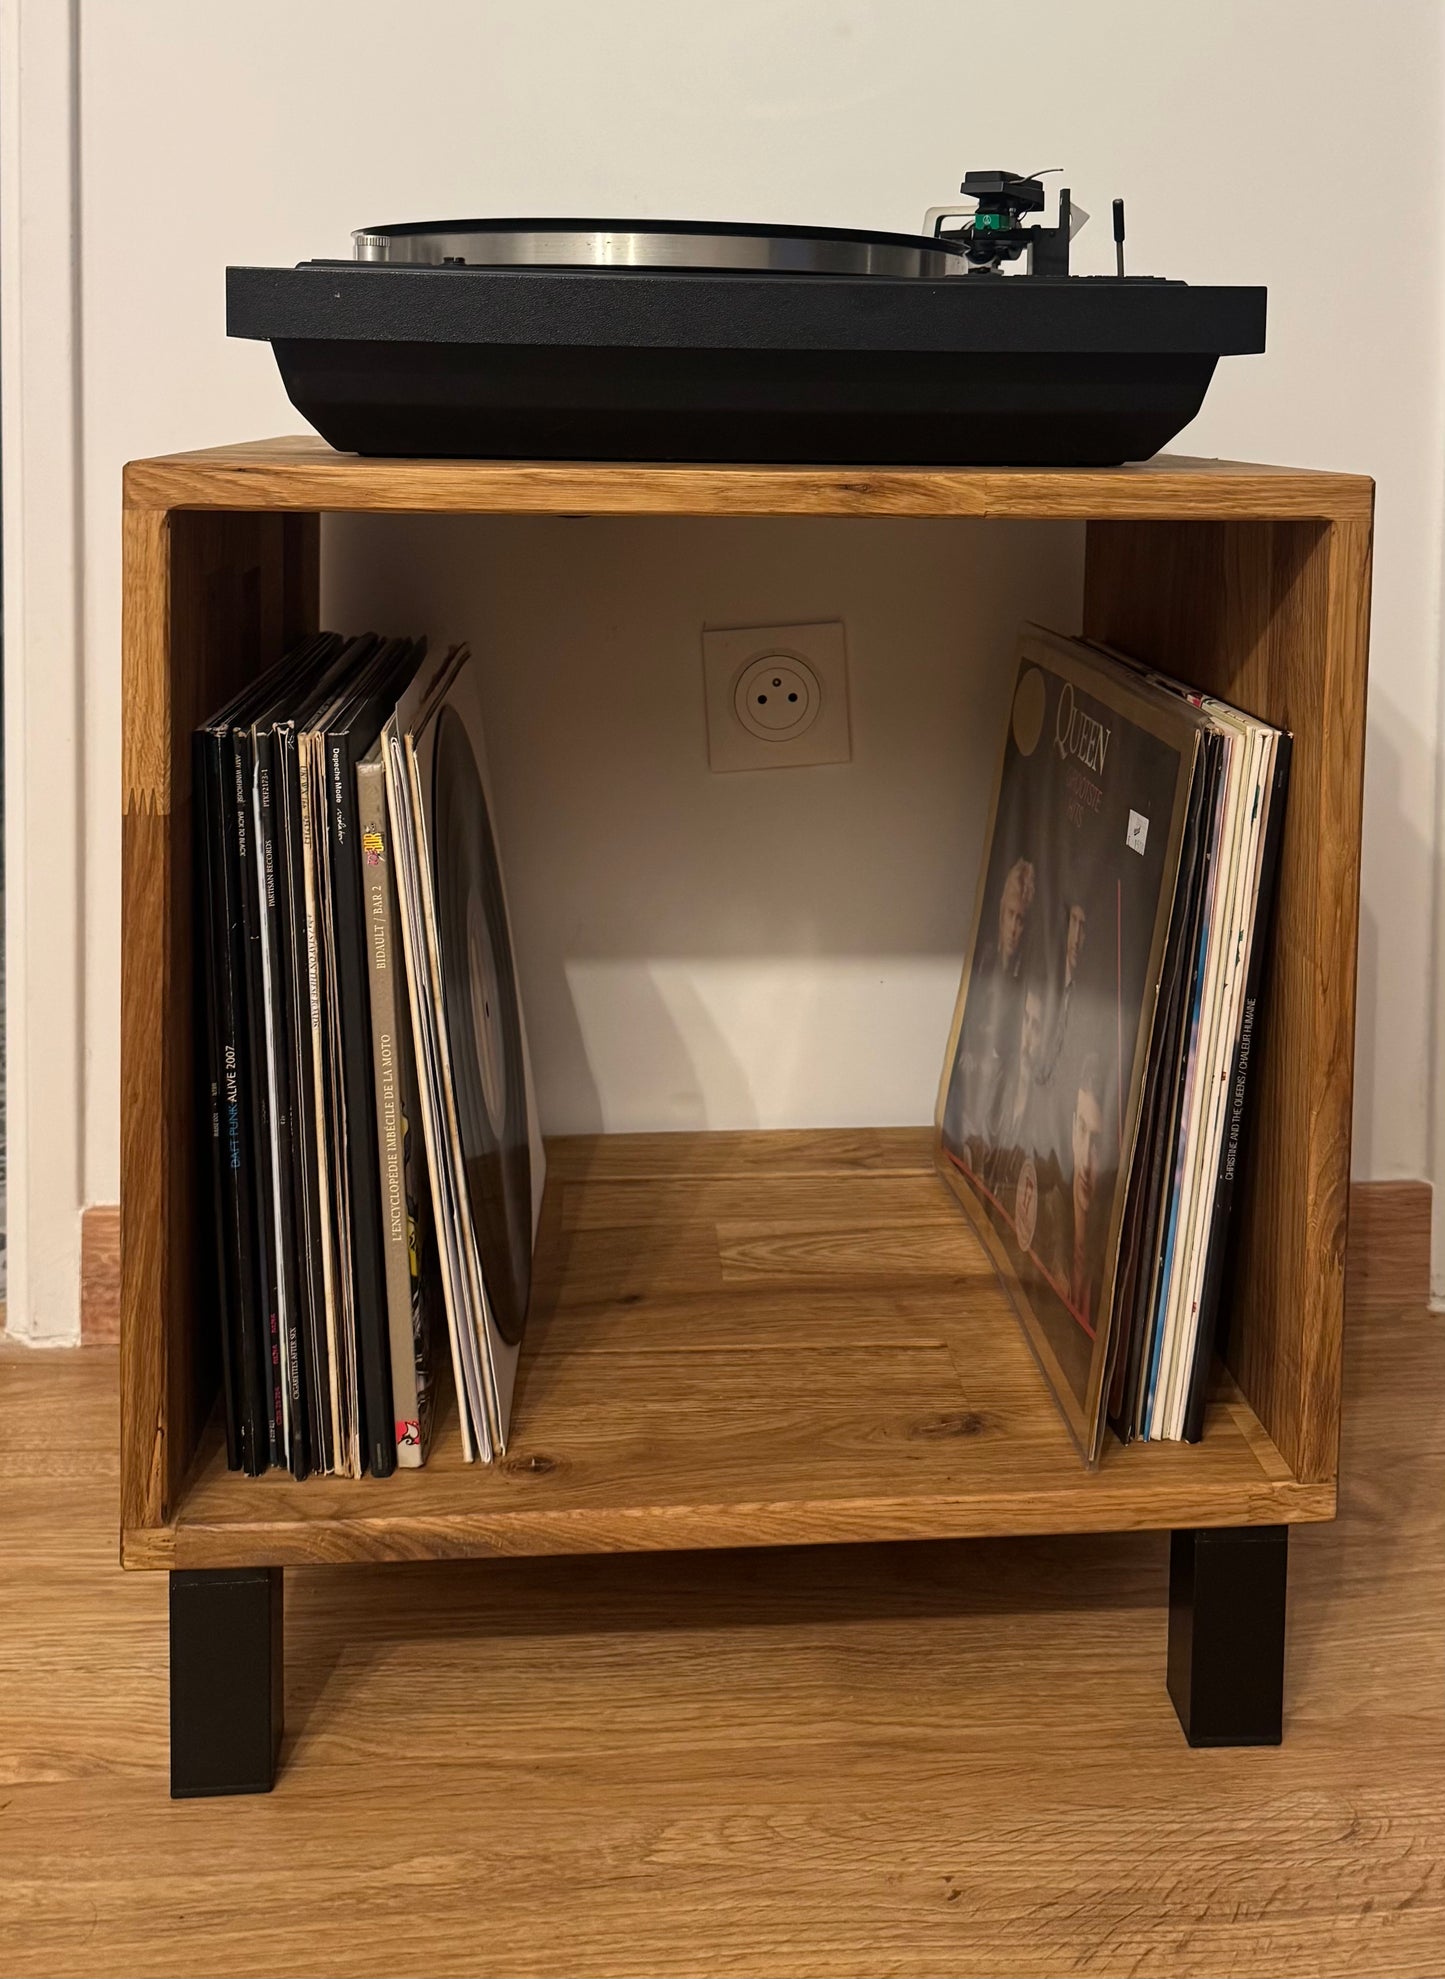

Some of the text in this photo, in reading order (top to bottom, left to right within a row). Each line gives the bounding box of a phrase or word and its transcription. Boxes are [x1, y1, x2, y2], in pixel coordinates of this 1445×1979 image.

[1054, 682, 1111, 776] QUEEN
[333, 748, 341, 780] Depeche
[268, 874, 276, 907] PARTISAN
[373, 894, 383, 914] BAR
[310, 956, 316, 970] ON
[375, 925, 386, 969] BIDAULT
[312, 999, 320, 1027] ROADS
[1245, 998, 1256, 1032] HUMAINE
[1239, 1034, 1251, 1069] CHALEUR
[226, 1045, 240, 1168] DAFT PUNK ALIVE 2007
[1235, 1076, 1246, 1106] QUEENS
[1233, 1108, 1242, 1121] THE
[381, 1034, 402, 1241] L'ENCYCLOPÉDIE IMBÉCILE DE LA MOTO
[1231, 1124, 1240, 1140] AND
[1225, 1141, 1238, 1180] CHRISTINE
